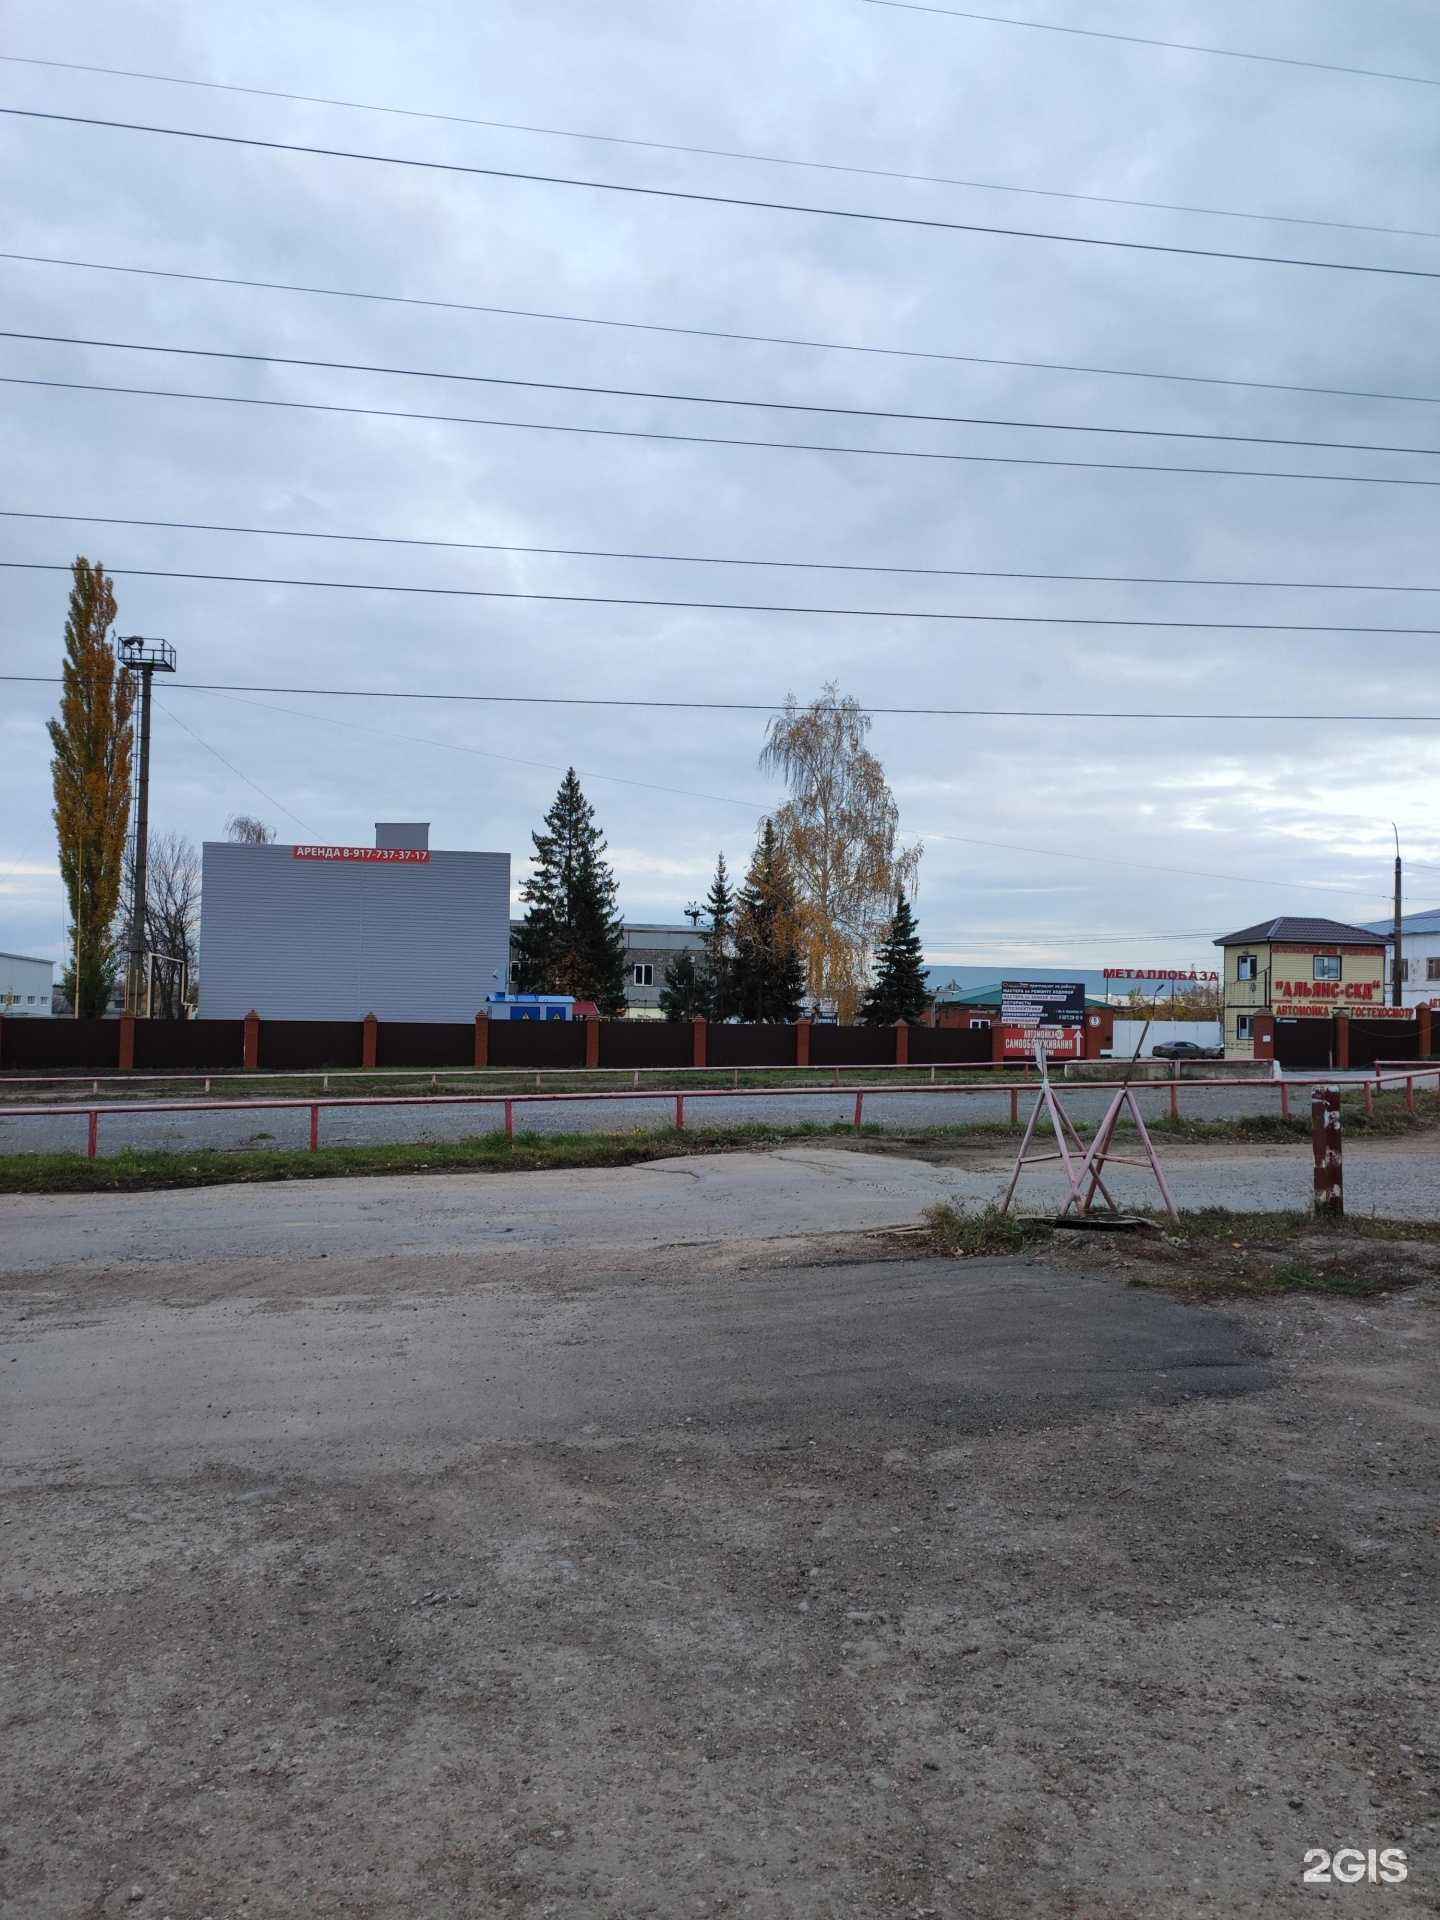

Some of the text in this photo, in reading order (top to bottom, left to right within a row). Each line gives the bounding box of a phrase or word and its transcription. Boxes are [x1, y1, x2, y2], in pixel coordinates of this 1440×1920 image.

[296, 847, 428, 860] АРЕНДА 8-917-737-37-17
[1103, 968, 1218, 981] МЕТАЛЛОБАЗА
[1276, 1005, 1330, 1017] АВТОМОЙКА
[1024, 1029, 1055, 1039] АВТОМОЙКА
